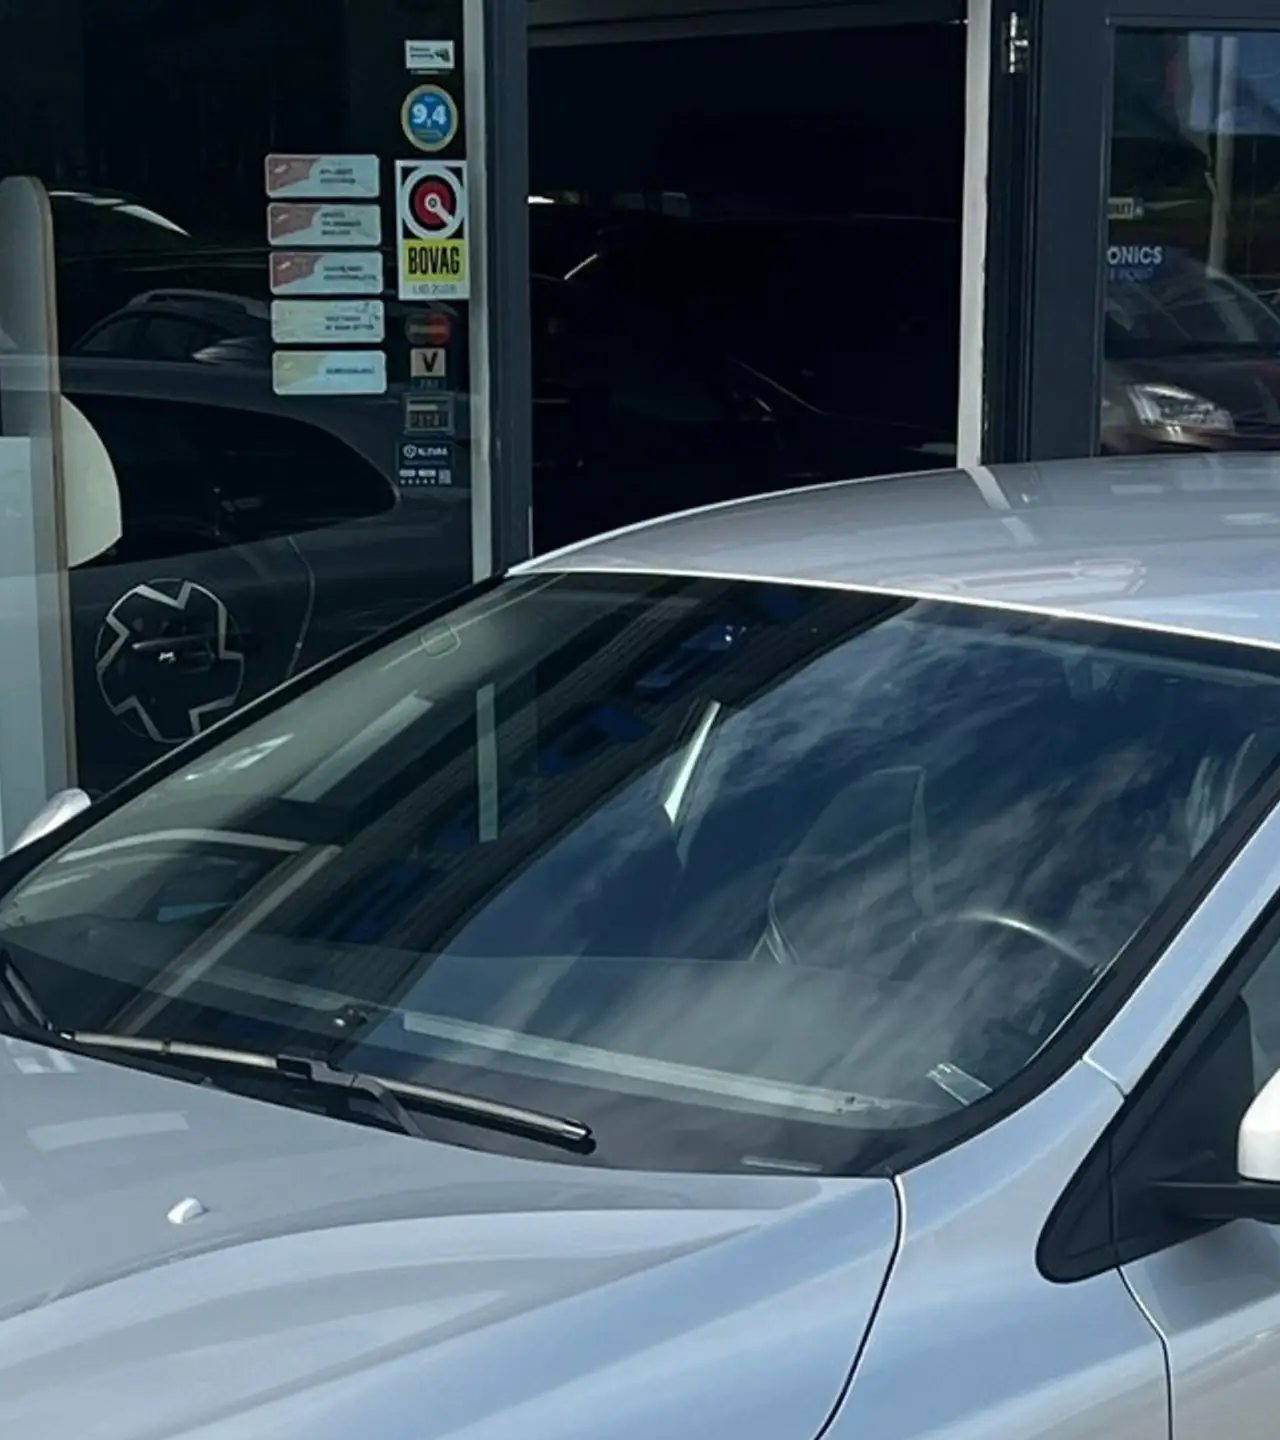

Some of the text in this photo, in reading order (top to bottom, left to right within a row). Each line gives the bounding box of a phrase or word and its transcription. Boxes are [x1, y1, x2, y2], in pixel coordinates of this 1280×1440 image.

[411, 102, 448, 127] 9,4
[408, 246, 460, 275] BOVAG
[422, 352, 438, 373] V
